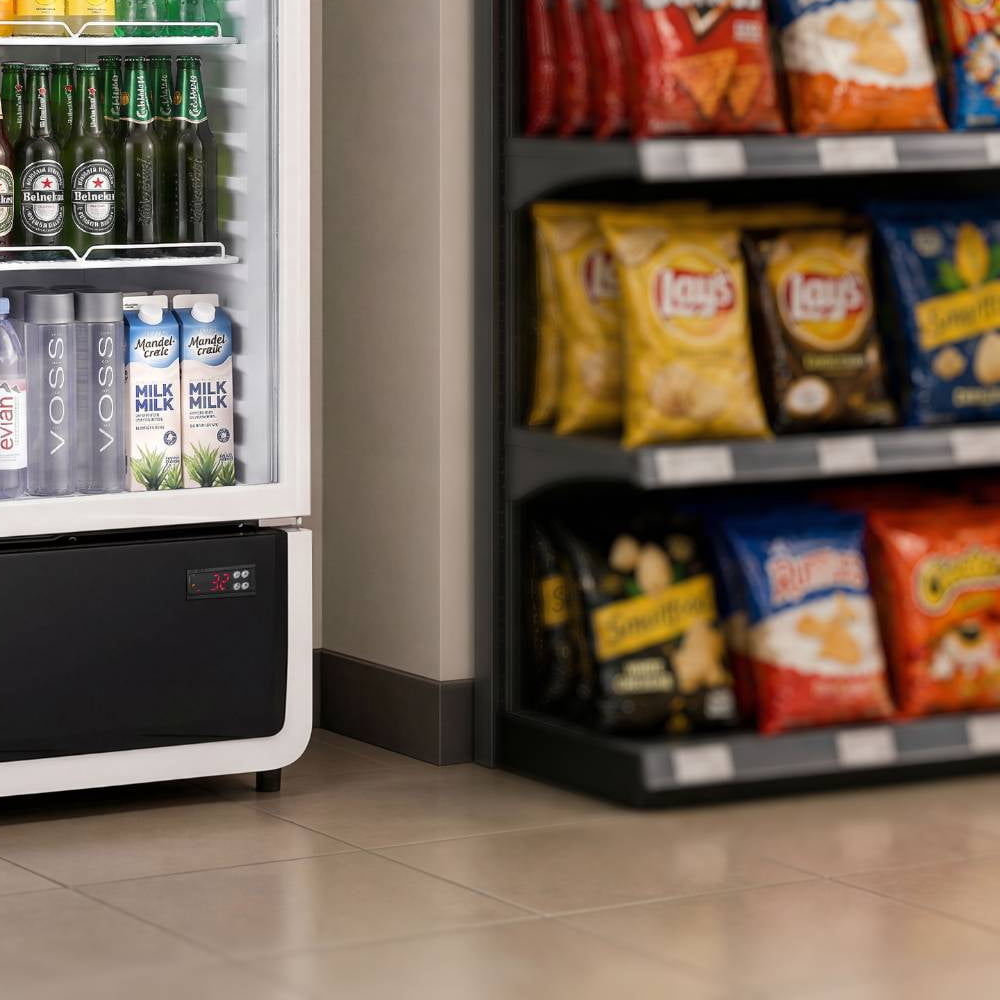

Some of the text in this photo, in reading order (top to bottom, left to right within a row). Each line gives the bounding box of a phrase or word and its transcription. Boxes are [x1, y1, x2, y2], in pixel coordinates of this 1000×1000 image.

[48, 336, 65, 455] VOSS
[98, 335, 115, 453] VOSS
[135, 383, 174, 398] MILK
[189, 380, 227, 396] MILK
[135, 397, 175, 413] MILK
[189, 394, 228, 410] MILK
